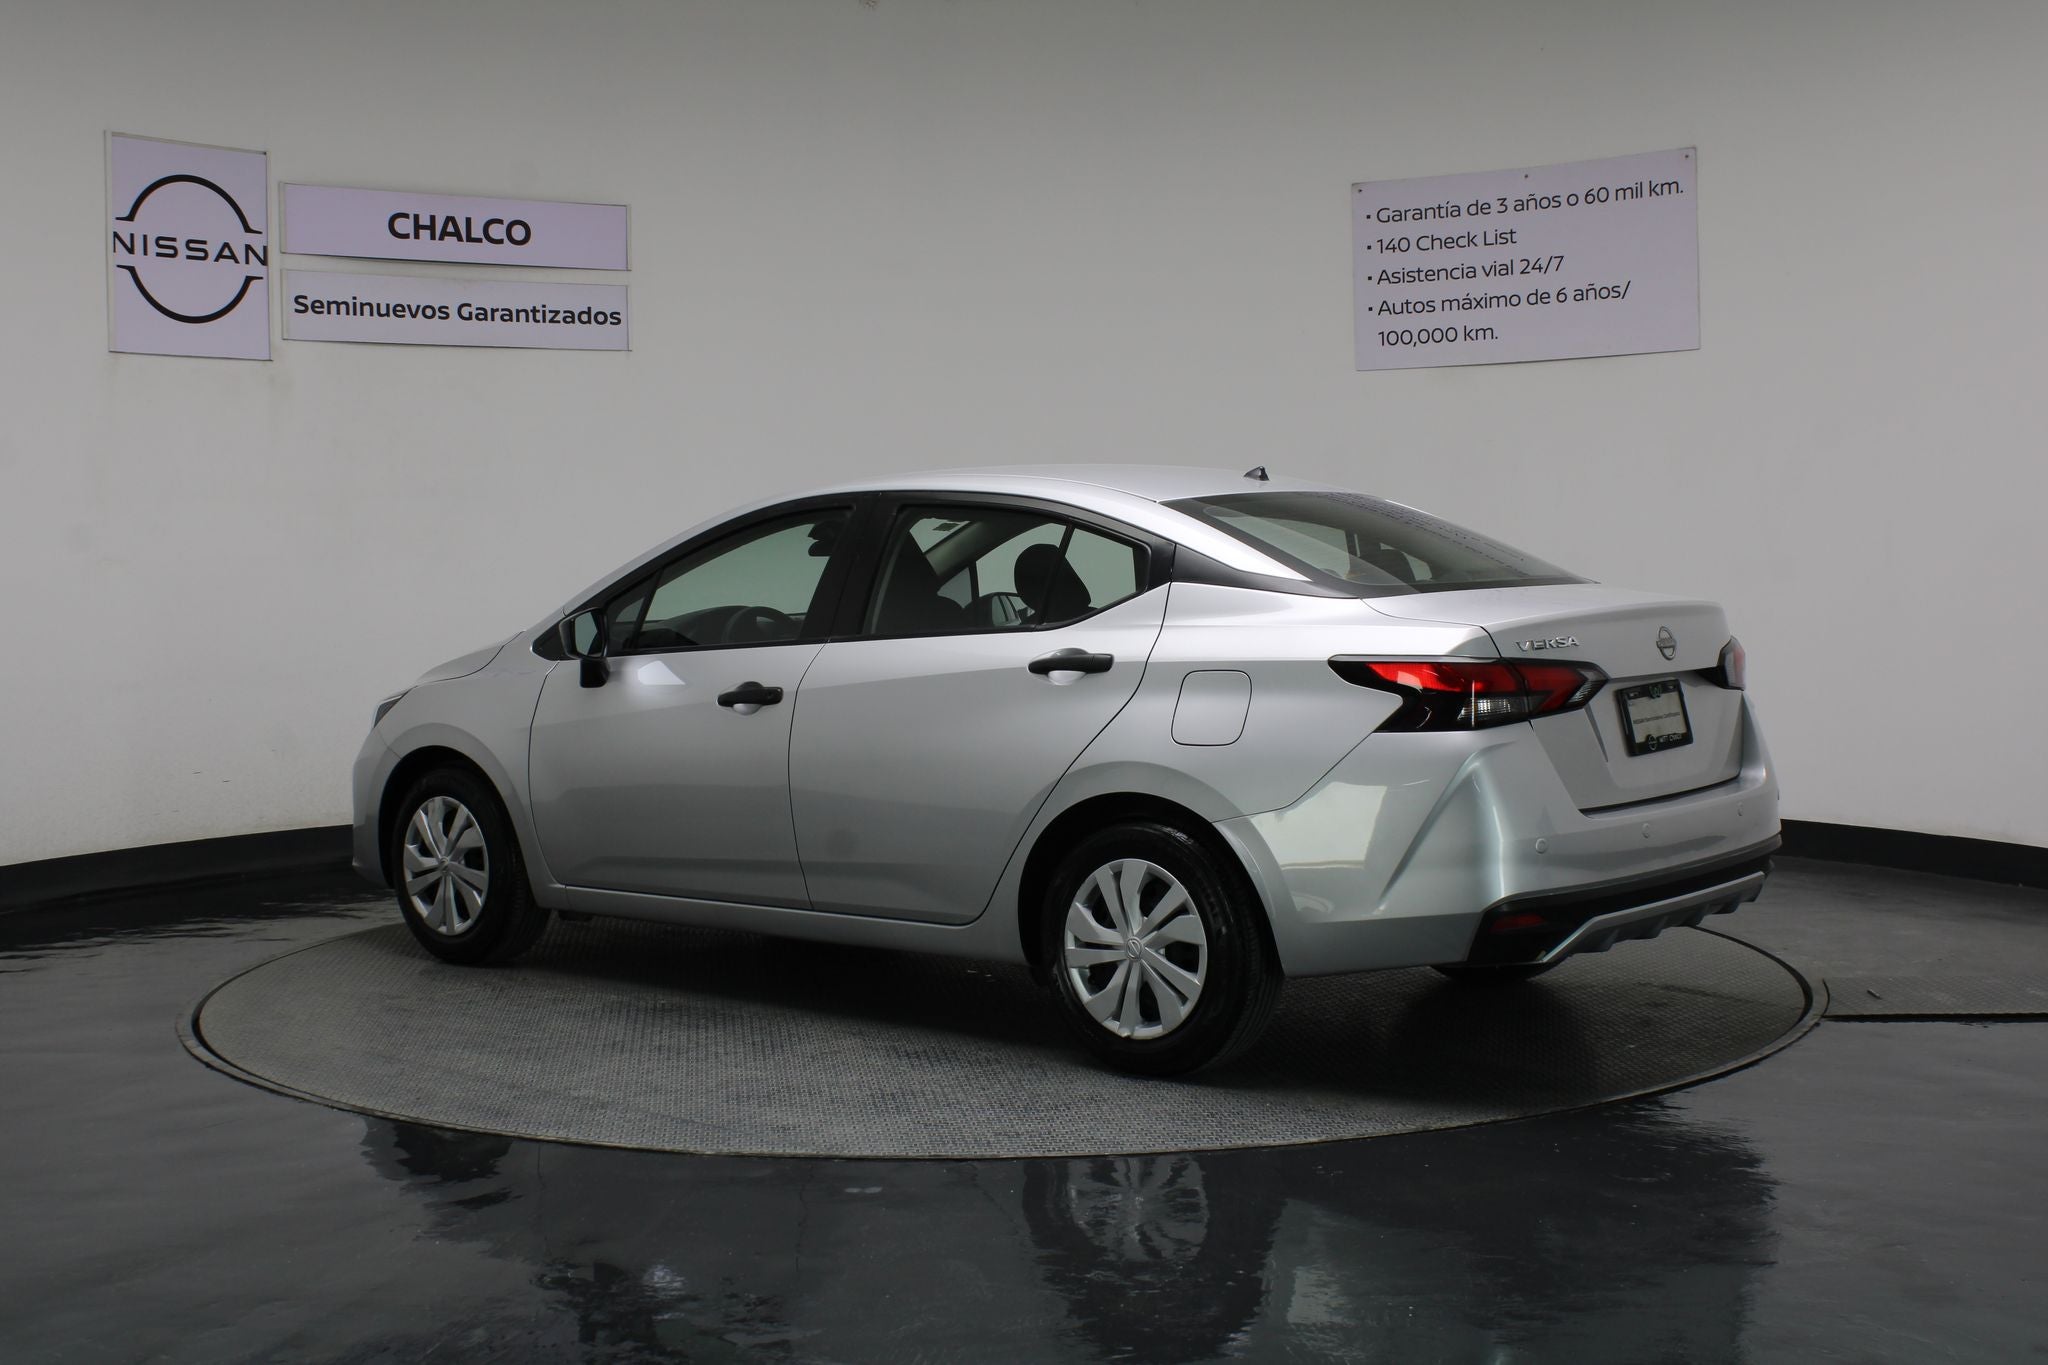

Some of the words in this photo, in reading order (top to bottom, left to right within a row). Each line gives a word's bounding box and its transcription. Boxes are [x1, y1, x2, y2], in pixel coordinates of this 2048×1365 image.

[1377, 201, 1461, 223] Garantía
[1467, 200, 1491, 216] de
[1497, 198, 1508, 213] 3
[1514, 194, 1561, 212] años
[1567, 194, 1579, 206] o
[1585, 187, 1609, 204] 60
[1616, 182, 1643, 201] mil
[1649, 180, 1683, 197] km.
[388, 212, 531, 246] CHALCO
[1377, 237, 1410, 254] 140
[1416, 232, 1478, 251] Check
[1484, 229, 1517, 246] List
[113, 231, 268, 267] NISSAN
[1377, 264, 1476, 285] Asistencia
[1482, 259, 1513, 277] vial
[1520, 256, 1564, 274] 24/7
[294, 295, 450, 320] Seminuevos
[457, 303, 621, 325] Garantizados
[1378, 299, 1435, 316] Autos
[1442, 293, 1521, 311] máximo
[1527, 289, 1550, 305] de
[1556, 287, 1567, 303] 6
[1573, 281, 1631, 301] años/
[1378, 327, 1457, 347] 100,000
[1464, 325, 1498, 341] km.
[1516, 636, 1580, 652] VERSA
